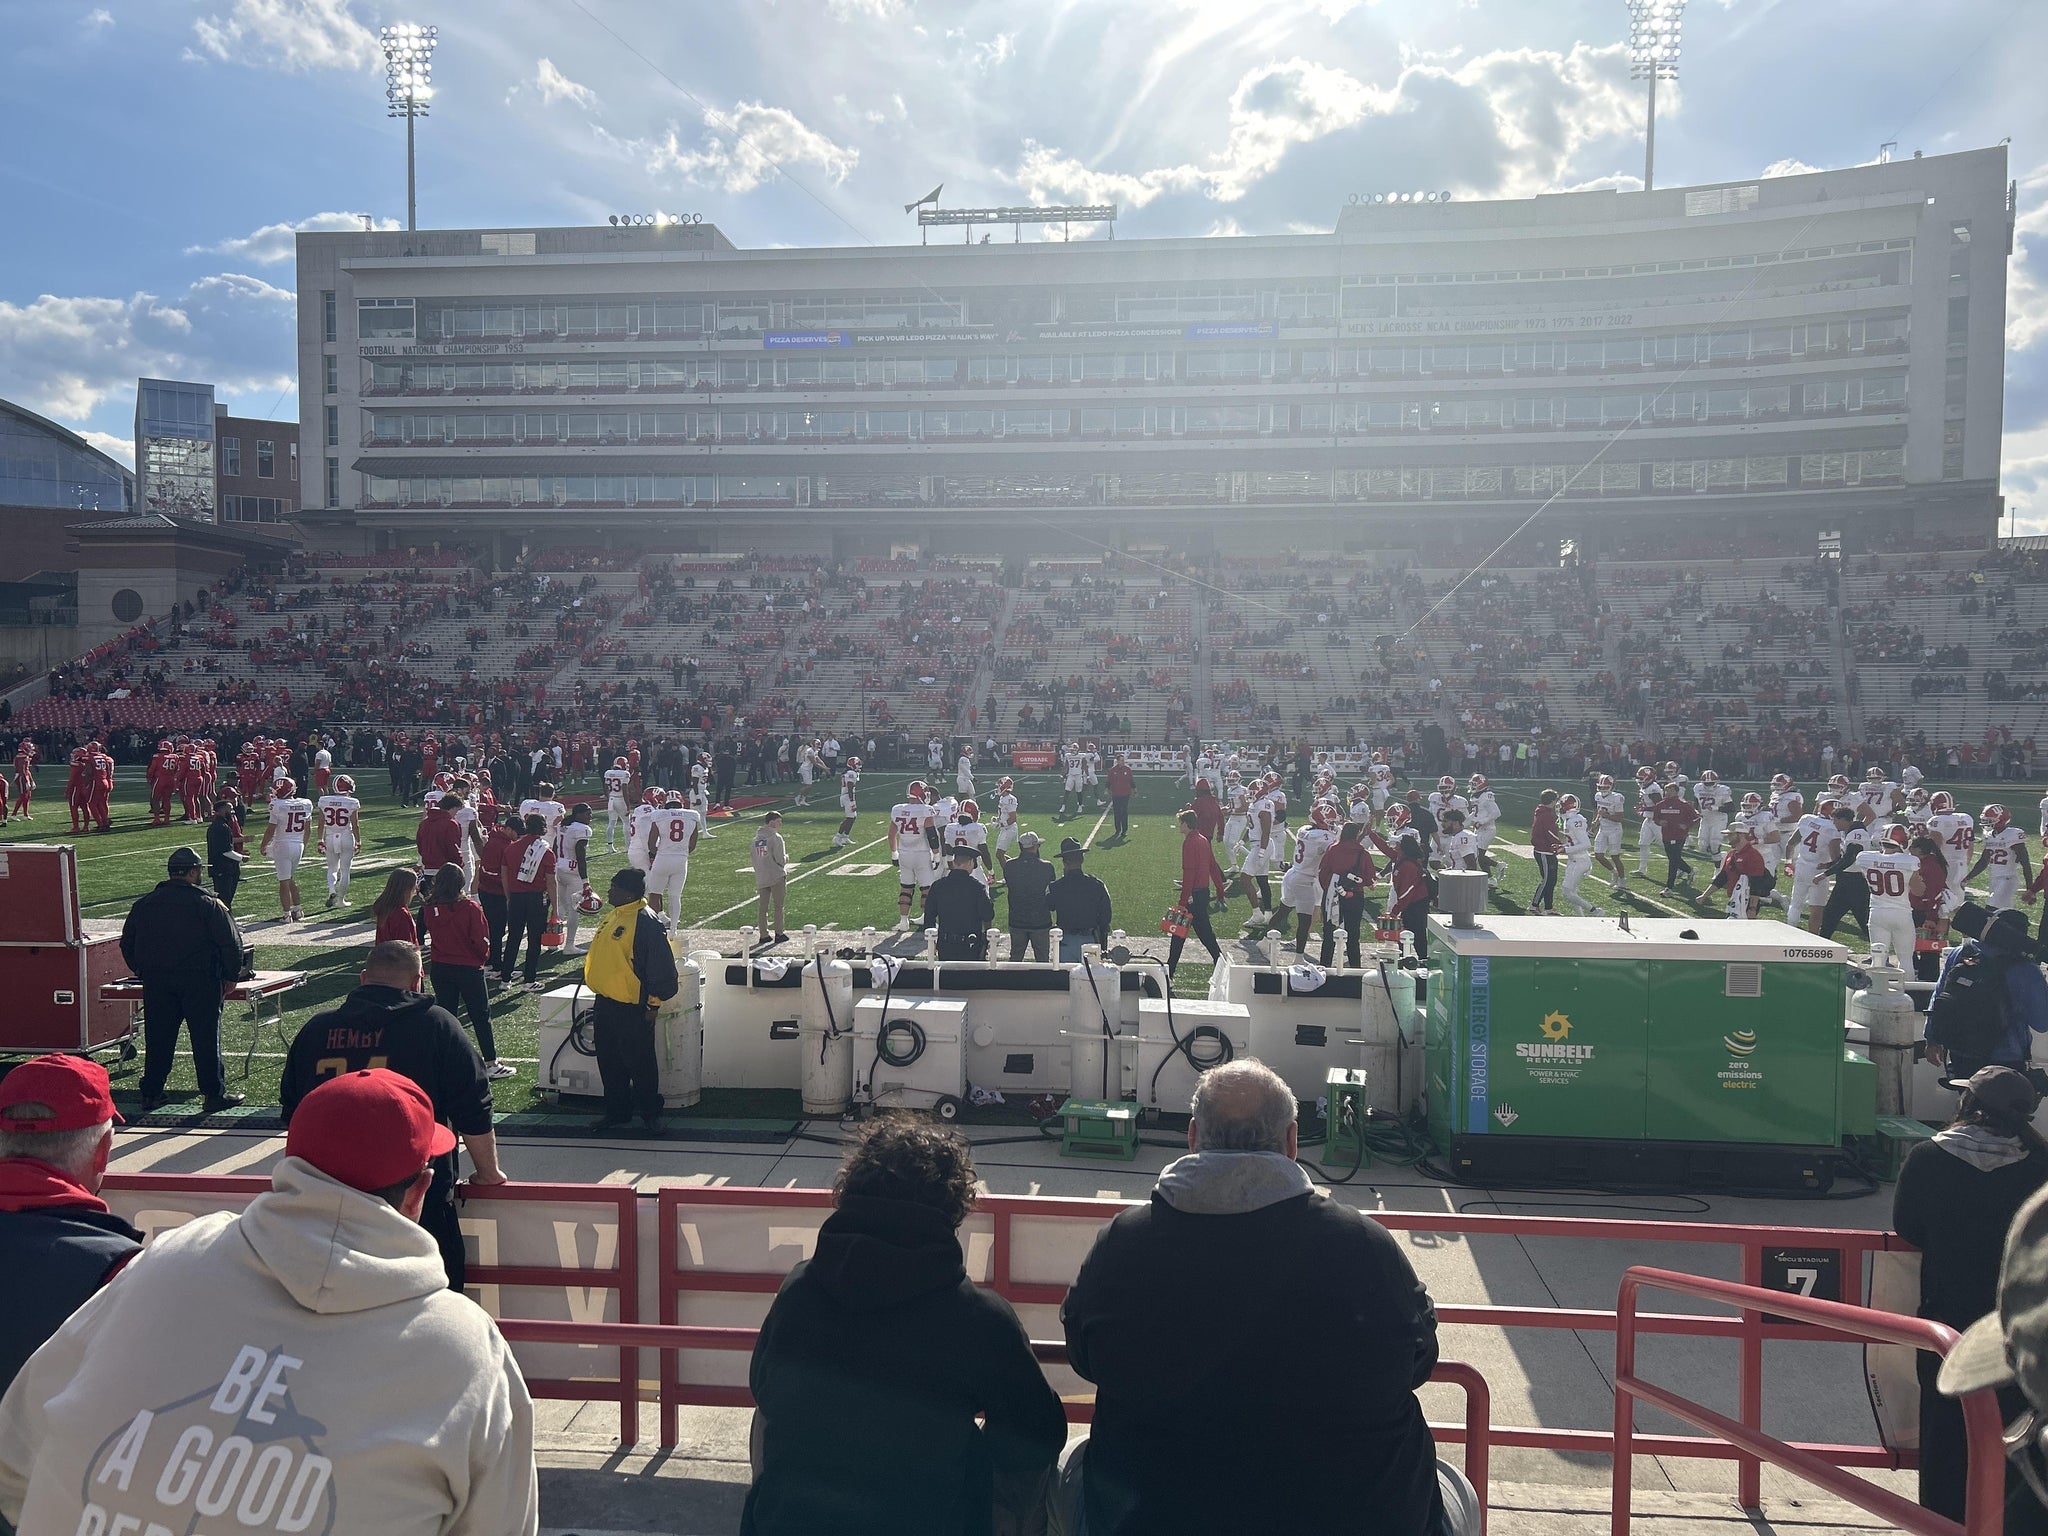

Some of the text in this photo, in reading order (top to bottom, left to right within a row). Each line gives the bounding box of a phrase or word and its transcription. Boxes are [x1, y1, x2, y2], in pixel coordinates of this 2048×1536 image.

[1454, 319, 1519, 331] CHAMPIONSHIP
[1608, 315, 1633, 326] 2022
[1108, 329, 1130, 337] PIZZA
[359, 343, 524, 355] FOOTBALL NATIONAL CHAMPIONSHIP 1953
[162, 757, 176, 770] 46
[189, 757, 201, 770] 50
[243, 760, 255, 770] 26
[1069, 759, 1080, 769] 37
[1865, 792, 1884, 805] 77
[285, 812, 306, 832] 15
[324, 807, 349, 826] 36
[669, 819, 684, 842] 8
[895, 817, 920, 834] 74
[1803, 831, 1820, 853] 4
[1946, 827, 1973, 850] 48
[1294, 840, 1305, 864] 3
[1866, 869, 1904, 897] 90
[1382, 931, 1389, 939] G
[1931, 941, 1939, 949] G
[1783, 949, 1833, 959] 10765696
[327, 1027, 384, 1049] HEMBY
[1471, 986, 1488, 1102] ENERGY STORAGE
[1516, 1043, 1594, 1058] SUNBELT
[1717, 1071, 1762, 1079] emissions
[1722, 1080, 1756, 1088] electric
[1787, 1268, 1818, 1297] 7
[209, 1344, 304, 1425] BE
[97, 1408, 333, 1532] A GOOD
